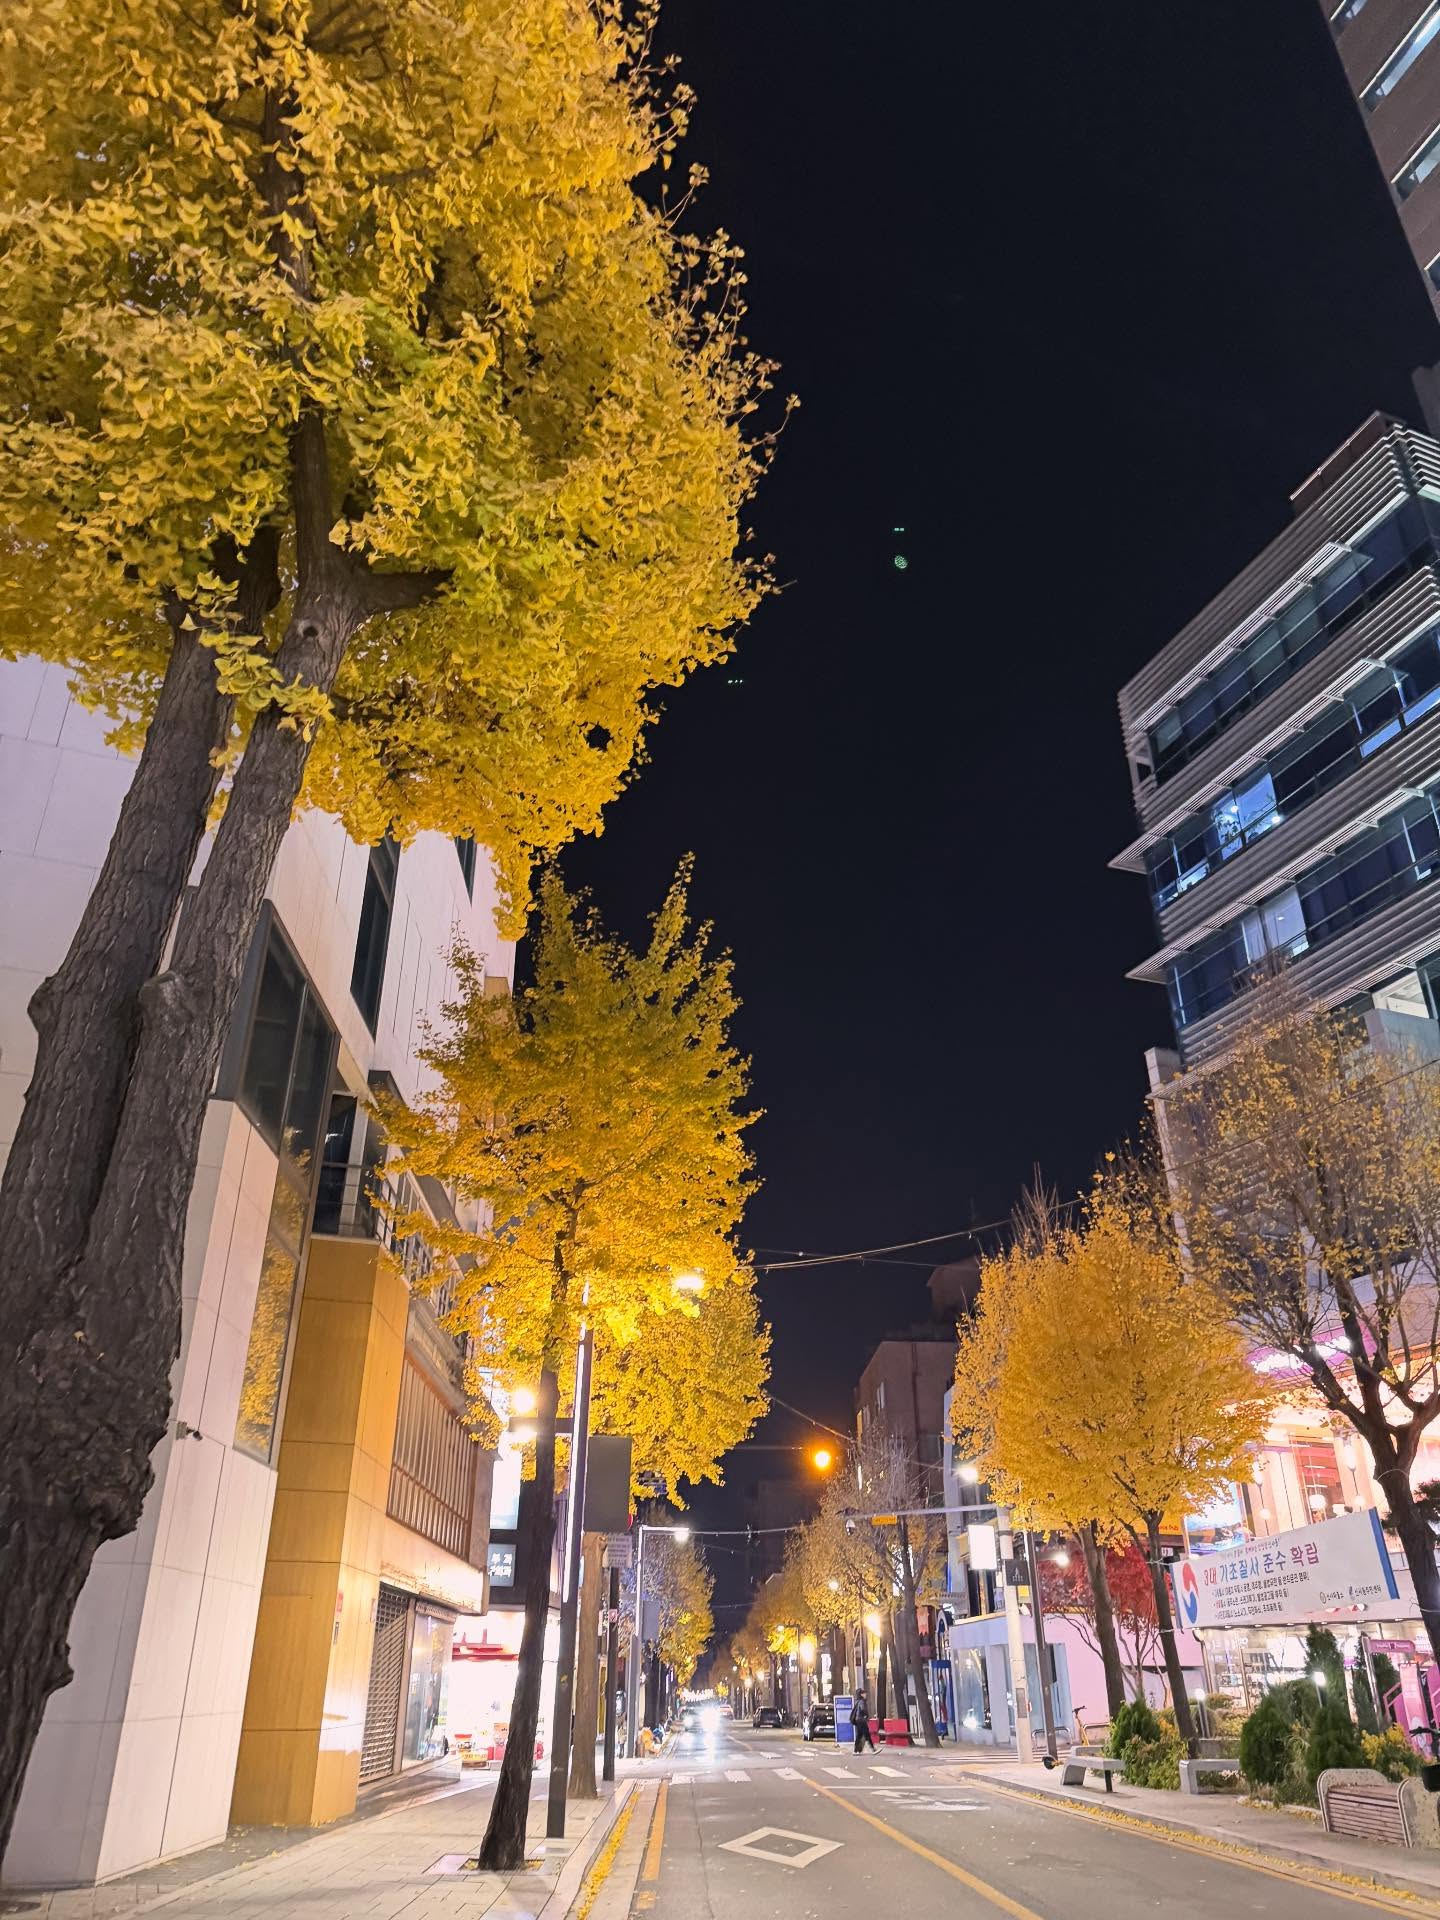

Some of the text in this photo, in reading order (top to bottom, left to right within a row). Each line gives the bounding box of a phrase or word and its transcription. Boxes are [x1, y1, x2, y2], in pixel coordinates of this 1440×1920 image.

[1220, 1556, 1260, 1582] 기초질서
[1263, 1551, 1286, 1573] 준수
[1290, 1542, 1319, 1566] 확립
